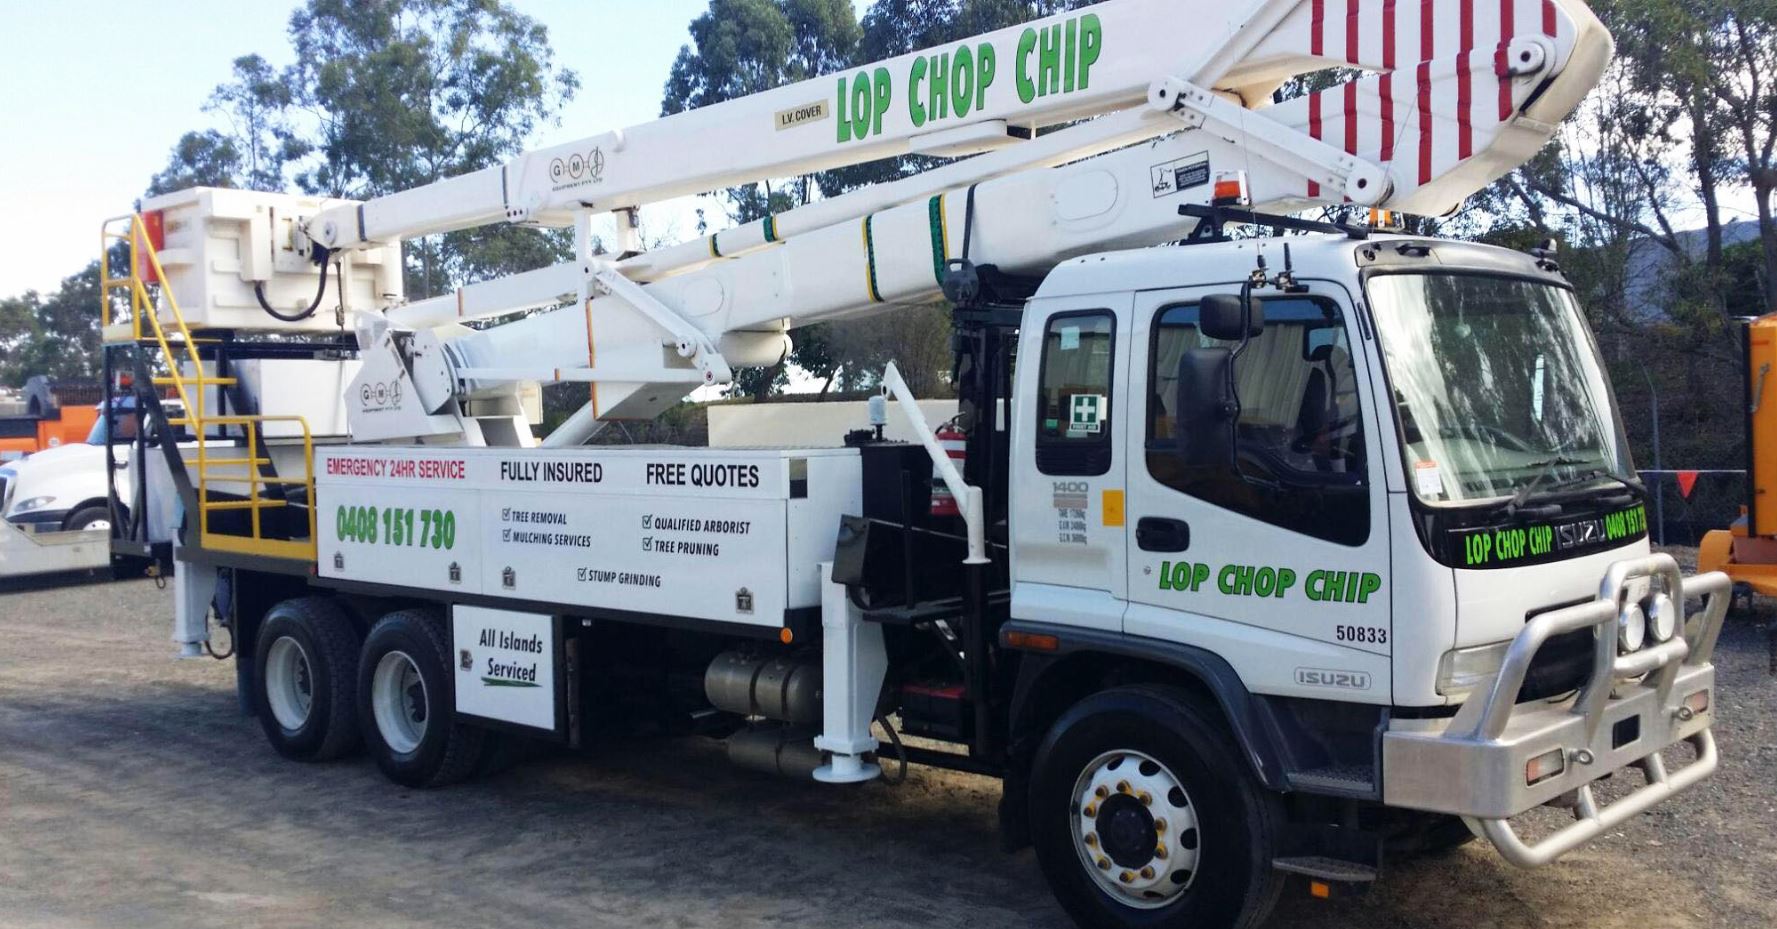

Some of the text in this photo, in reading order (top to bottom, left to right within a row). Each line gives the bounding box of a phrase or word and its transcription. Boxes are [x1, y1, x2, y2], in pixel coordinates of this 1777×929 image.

[836, 13, 1102, 143] LOP CHOP CHIP
[795, 105, 822, 121] COVER
[327, 458, 465, 479] EMERGENCY 24HR SERVICE
[501, 461, 603, 483] FULLY INSURED
[646, 463, 759, 488] FREE QUOTES
[1053, 482, 1088, 492] 1400
[336, 505, 456, 550] 0408 151 730
[512, 511, 567, 525] TREE REMOVAL
[654, 517, 751, 534] QUALIFIED ARBORIST
[1605, 511, 1627, 540] 0408
[1626, 508, 1639, 535] 151
[512, 531, 591, 547] MULCHING SERVICES
[1465, 525, 1552, 565] LOP CHOP CHIP
[1554, 519, 1605, 550] ISUZU
[655, 540, 719, 556] TREE PRUNING
[588, 569, 661, 588] STUMP GRINDING
[1159, 561, 1382, 604] LOP CHOP CHIP
[479, 629, 543, 654] All Islands
[1336, 625, 1387, 644] 50833
[487, 657, 536, 682] Serviced
[1299, 671, 1365, 688] ISUZU
